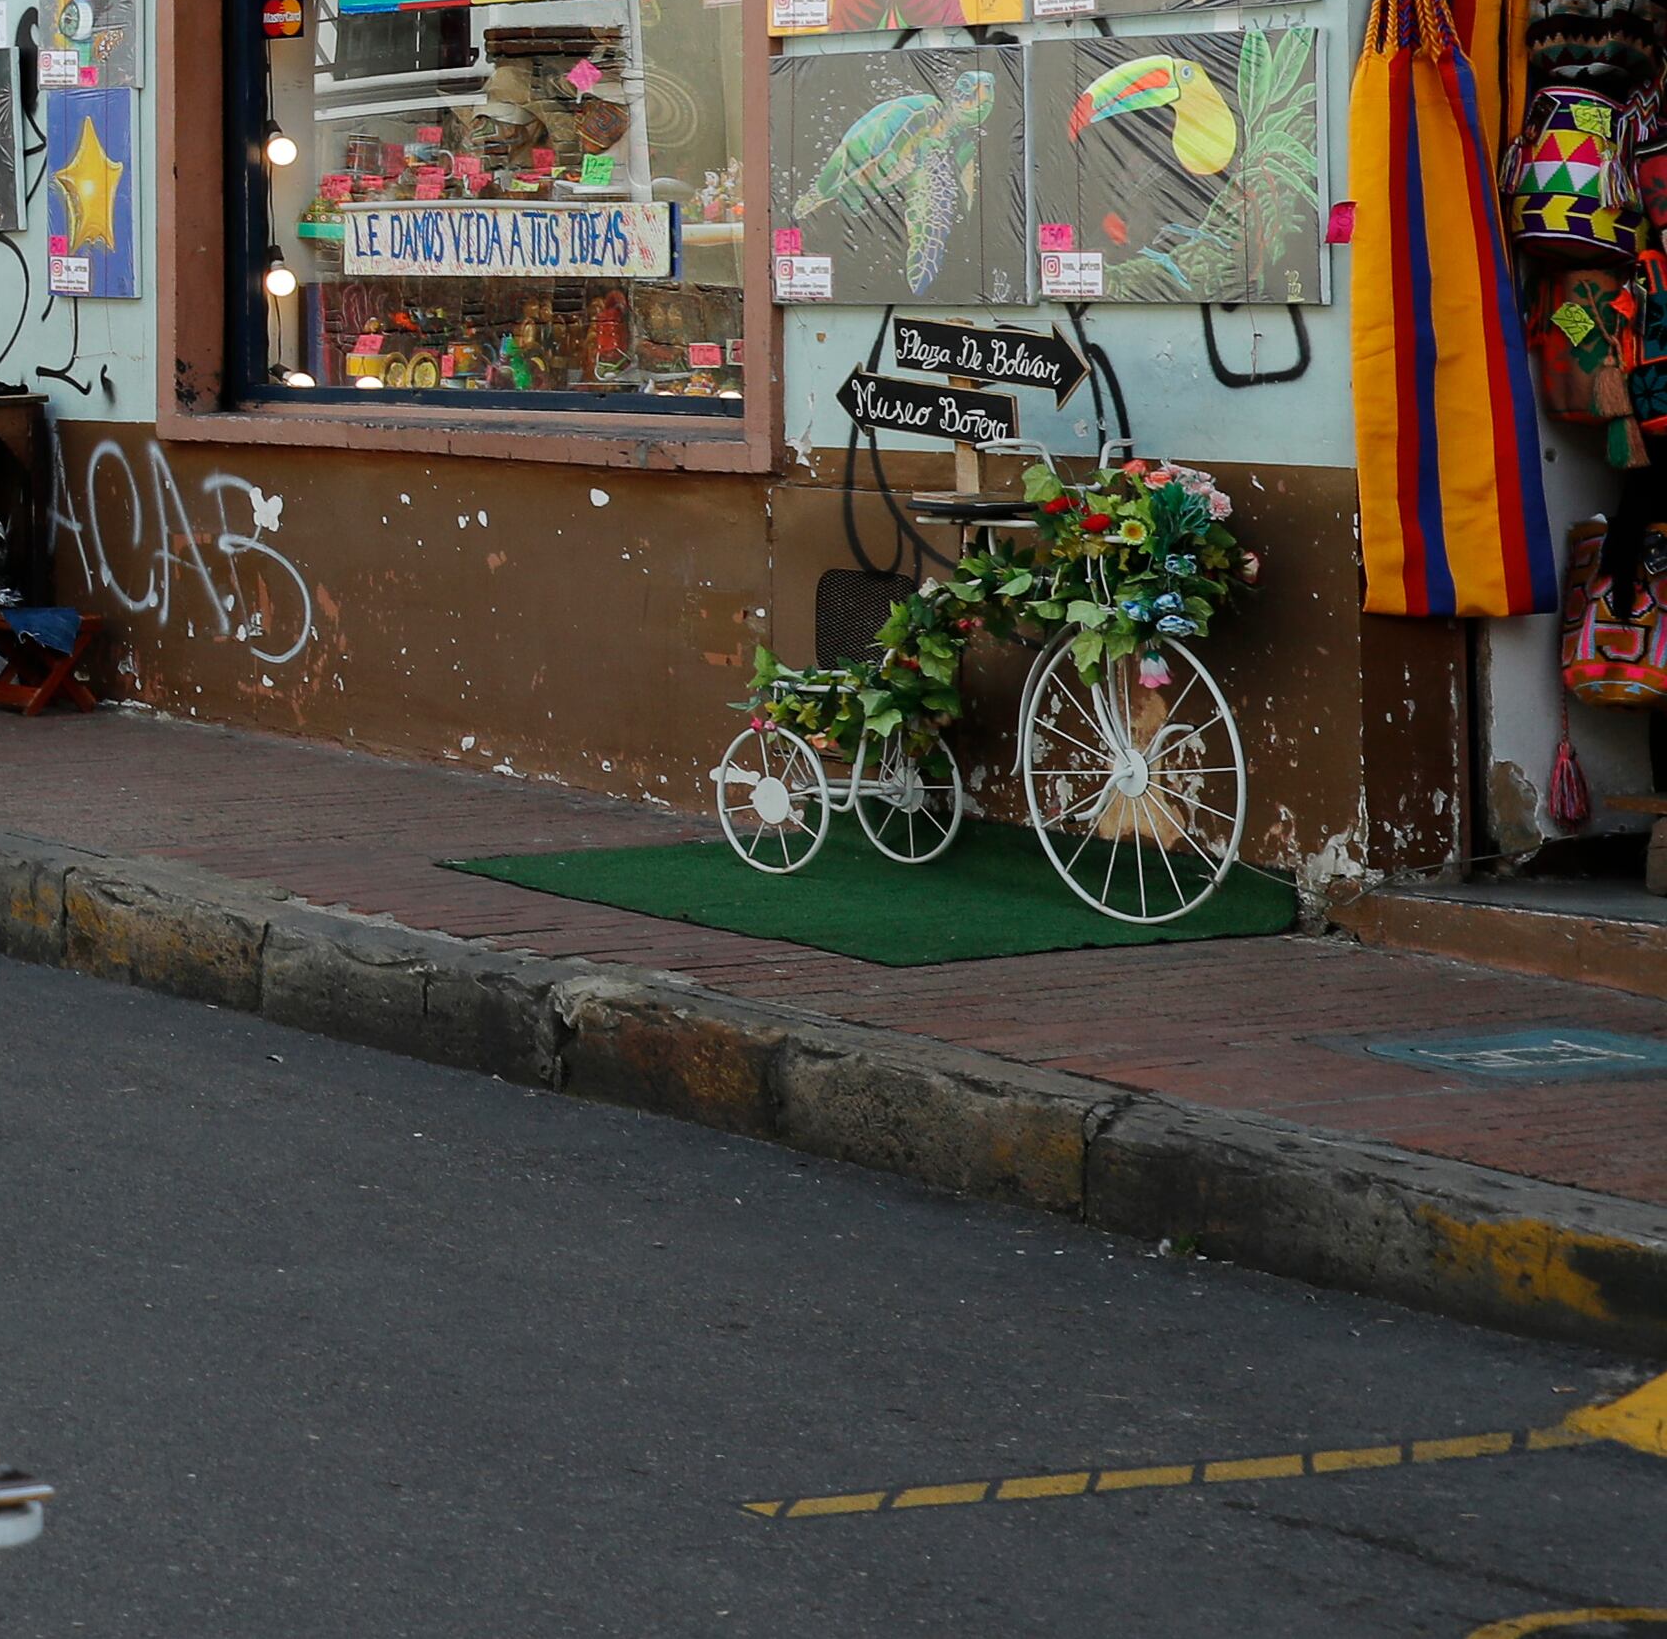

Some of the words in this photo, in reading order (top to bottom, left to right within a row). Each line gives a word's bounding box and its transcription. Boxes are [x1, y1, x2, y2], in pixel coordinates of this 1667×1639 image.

[262, 9, 302, 24] MasterCard
[352, 214, 381, 259] LE
[390, 210, 445, 262] DAMOS
[448, 212, 504, 266] VIDA
[510, 213, 524, 266] A
[521, 211, 561, 267] TUS
[568, 210, 630, 268] IDEAS
[895, 326, 951, 370] Plaza
[956, 335, 982, 371] De
[851, 379, 934, 426] Museo
[938, 394, 1010, 441] Botero
